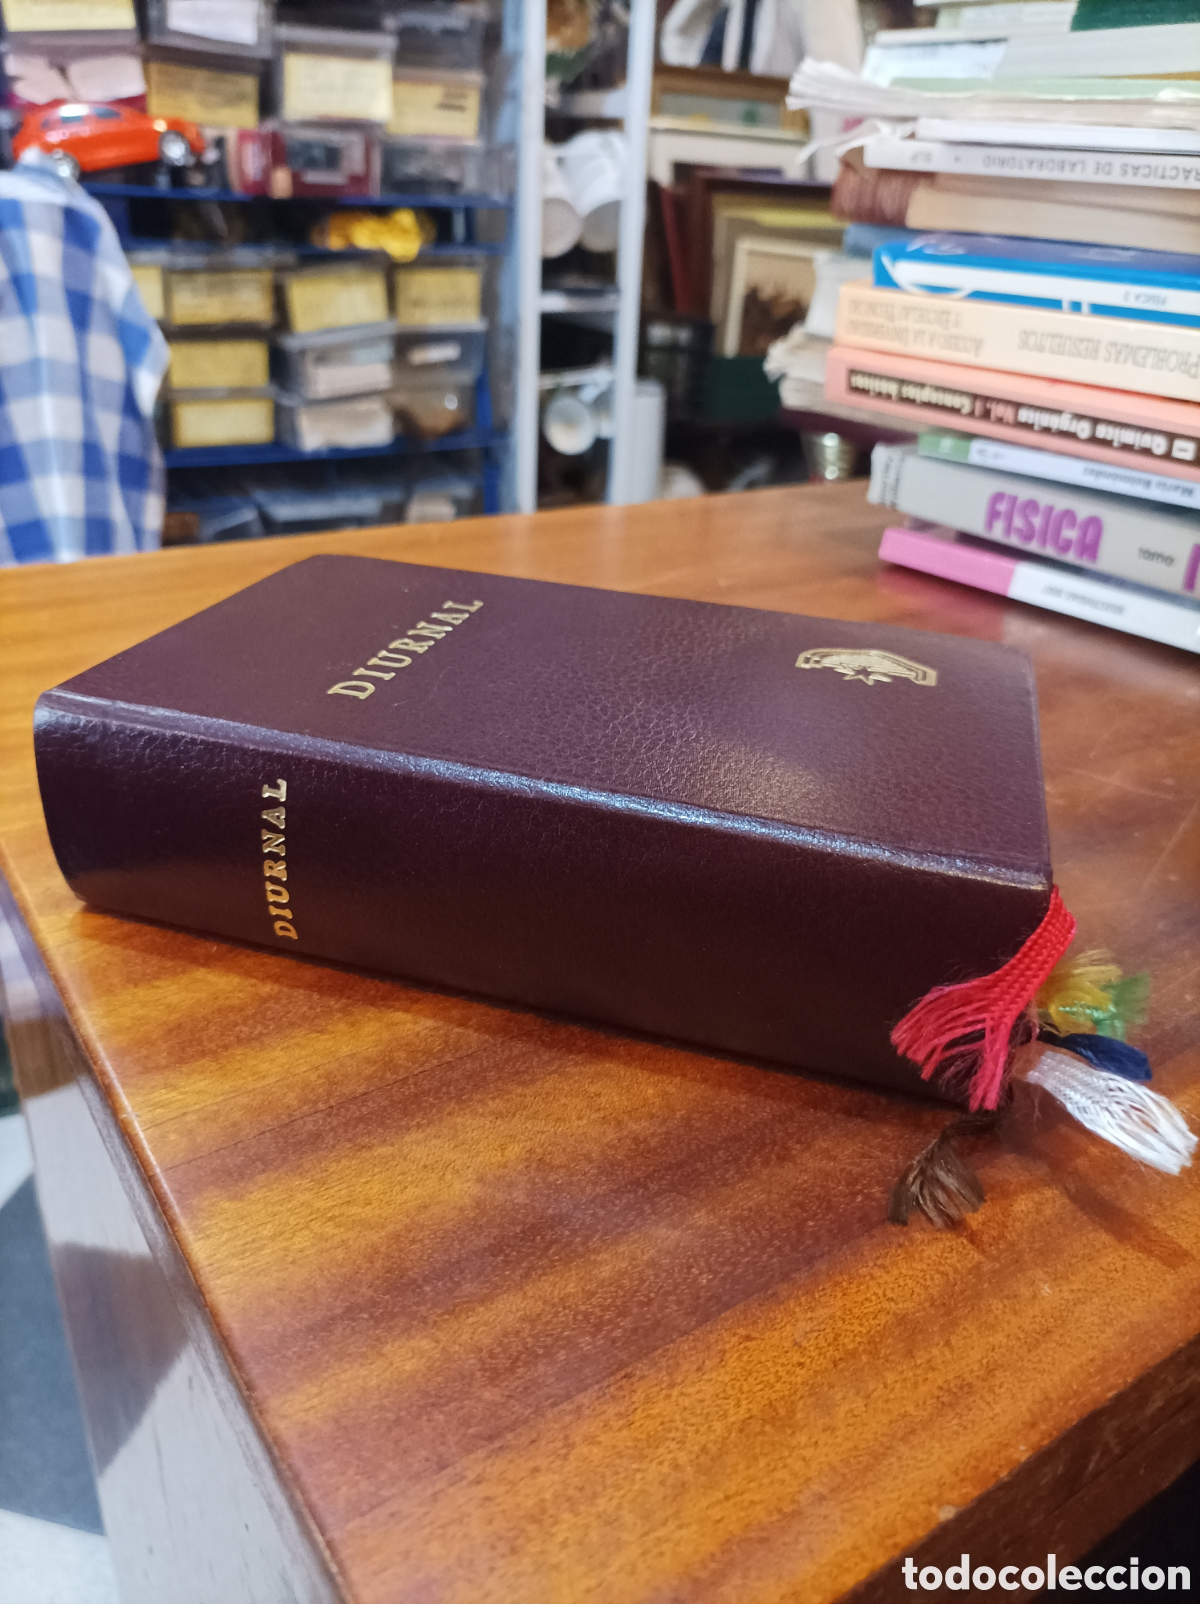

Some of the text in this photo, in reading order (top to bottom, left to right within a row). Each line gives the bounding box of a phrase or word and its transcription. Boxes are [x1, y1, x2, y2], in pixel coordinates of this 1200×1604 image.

[981, 154, 1086, 173] LABORATORIO
[1094, 161, 1112, 175] DE
[1016, 328, 1200, 378] PROBLEMAS RESUELTOS
[326, 600, 484, 700] DIURNAL
[262, 778, 298, 940] DIURNAL
